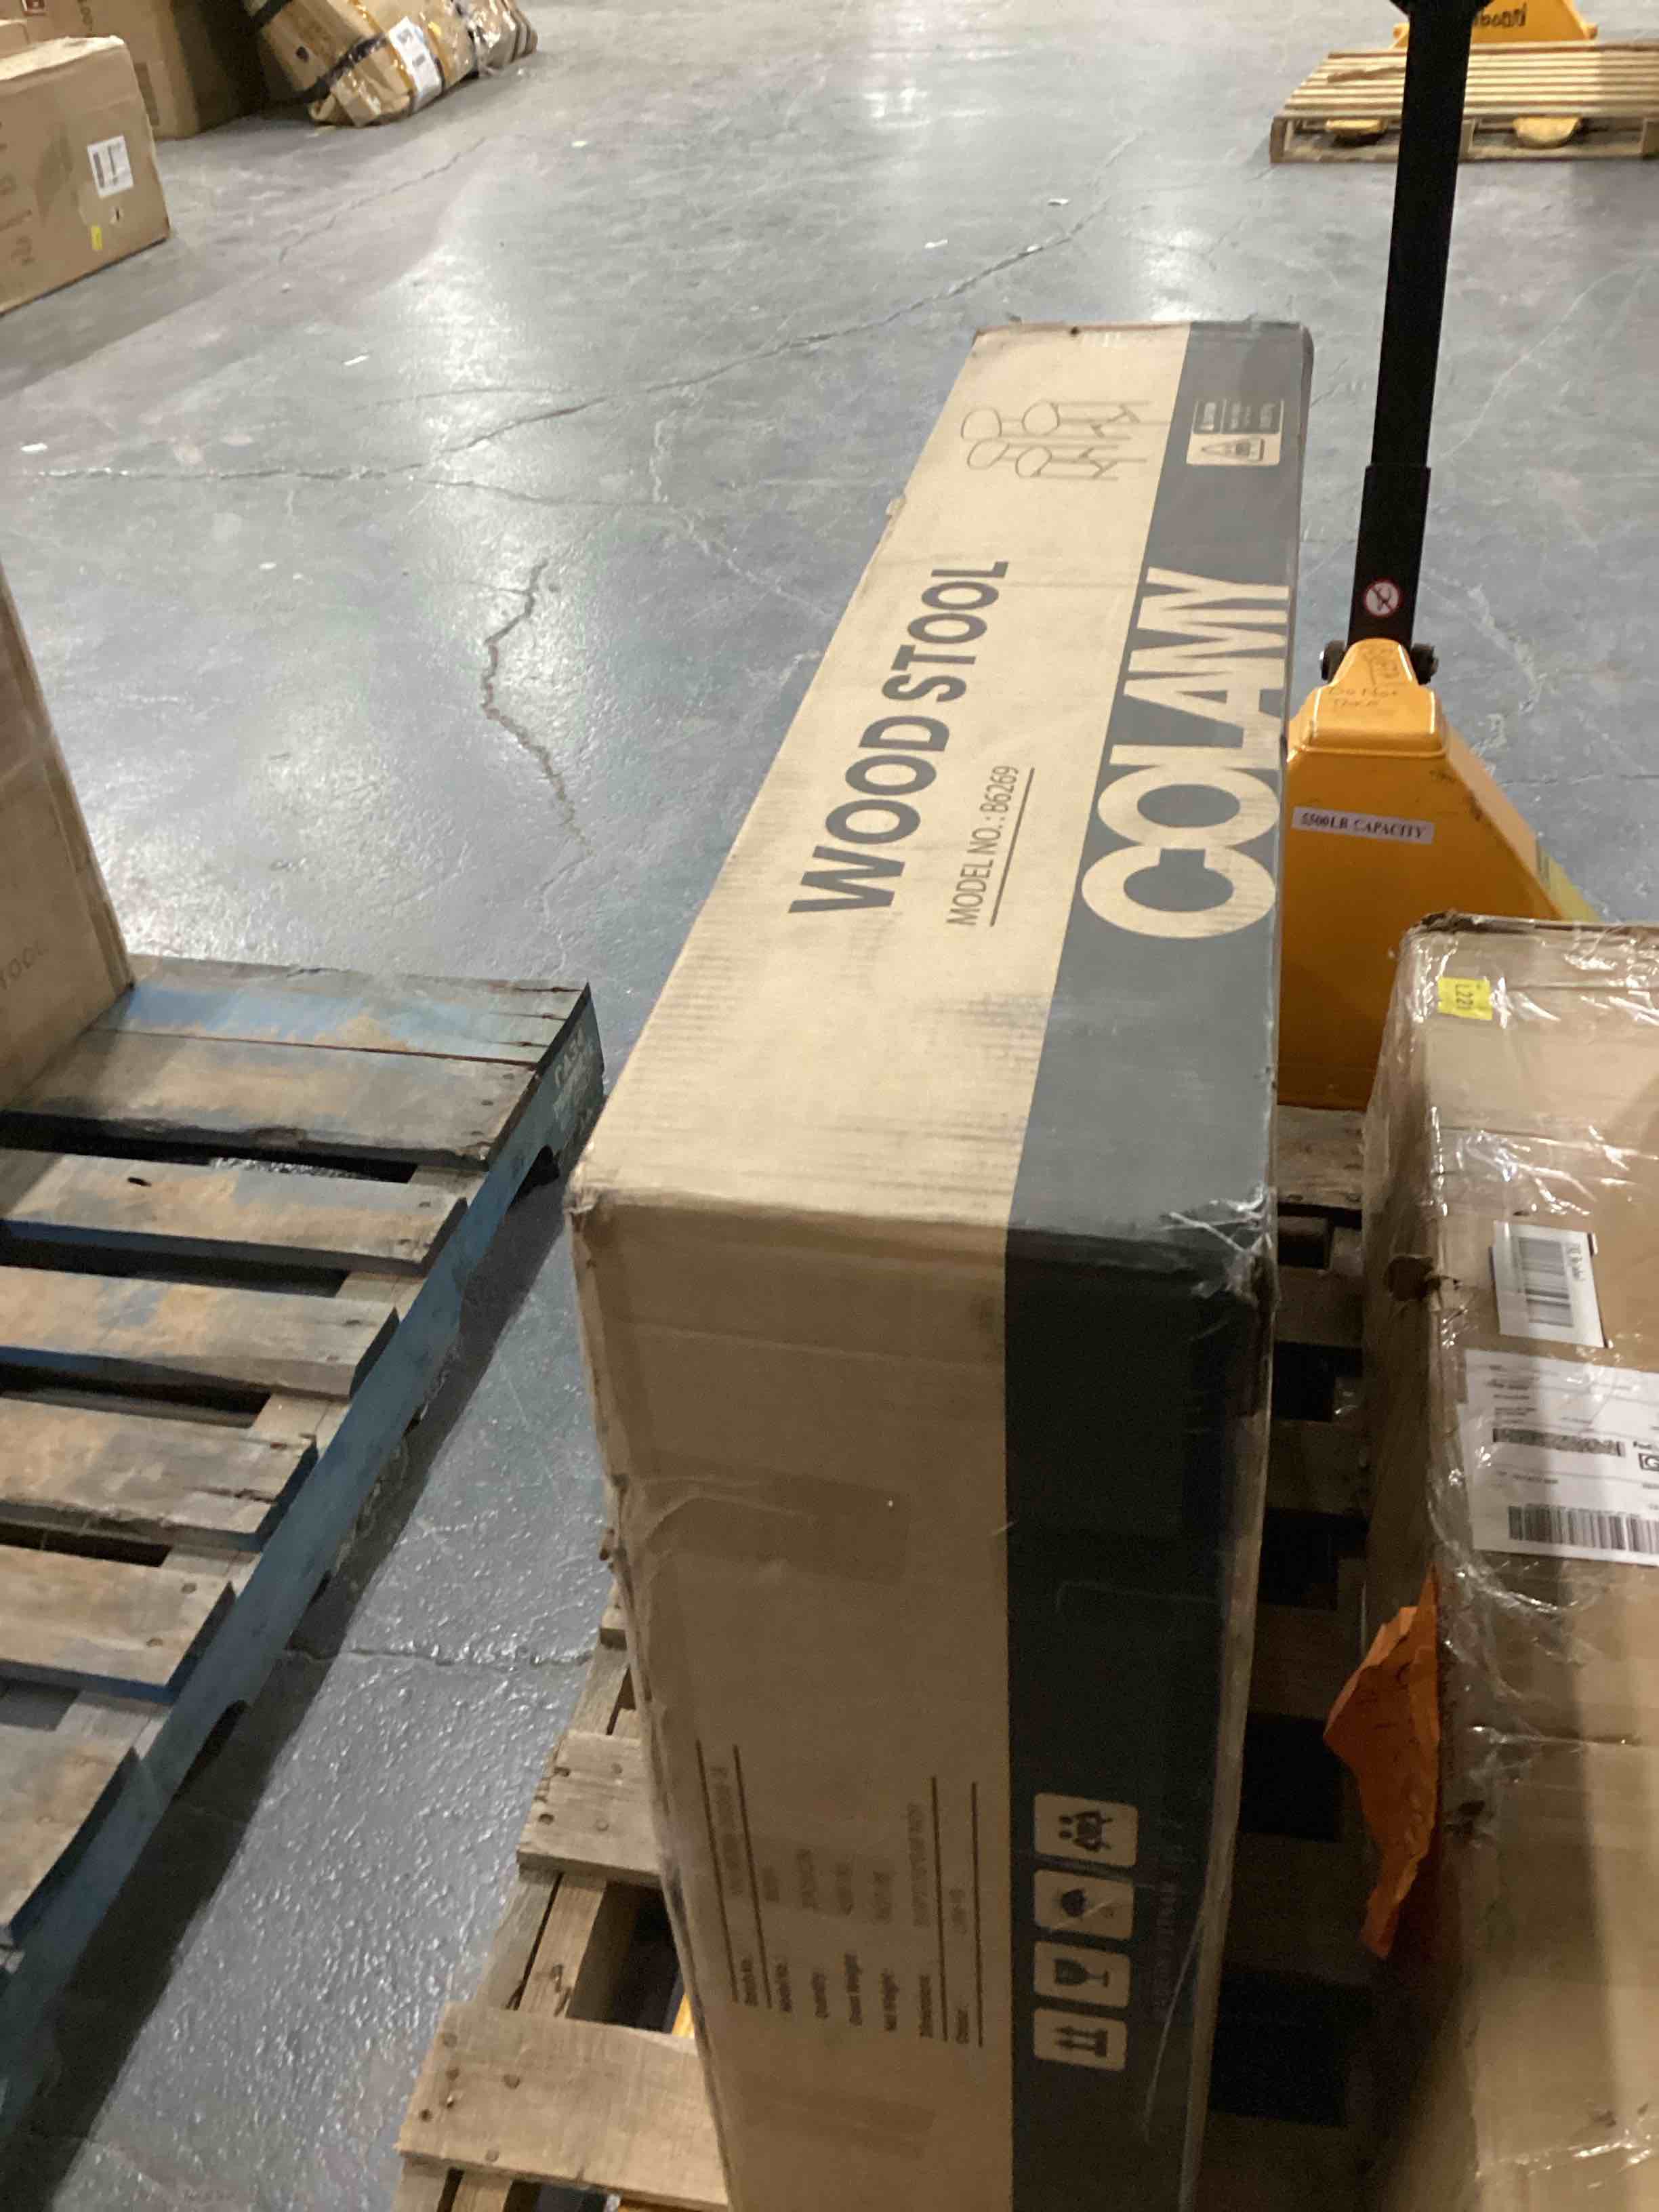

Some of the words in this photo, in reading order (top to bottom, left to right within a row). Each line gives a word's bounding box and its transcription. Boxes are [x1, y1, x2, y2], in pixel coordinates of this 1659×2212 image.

[788, 715, 950, 914] WOOD
[881, 561, 1008, 702] STOOL
[1082, 567, 1290, 937] COLAMY
[1353, 820, 1426, 838] CAPACITY
[946, 859, 994, 926] MODEL
